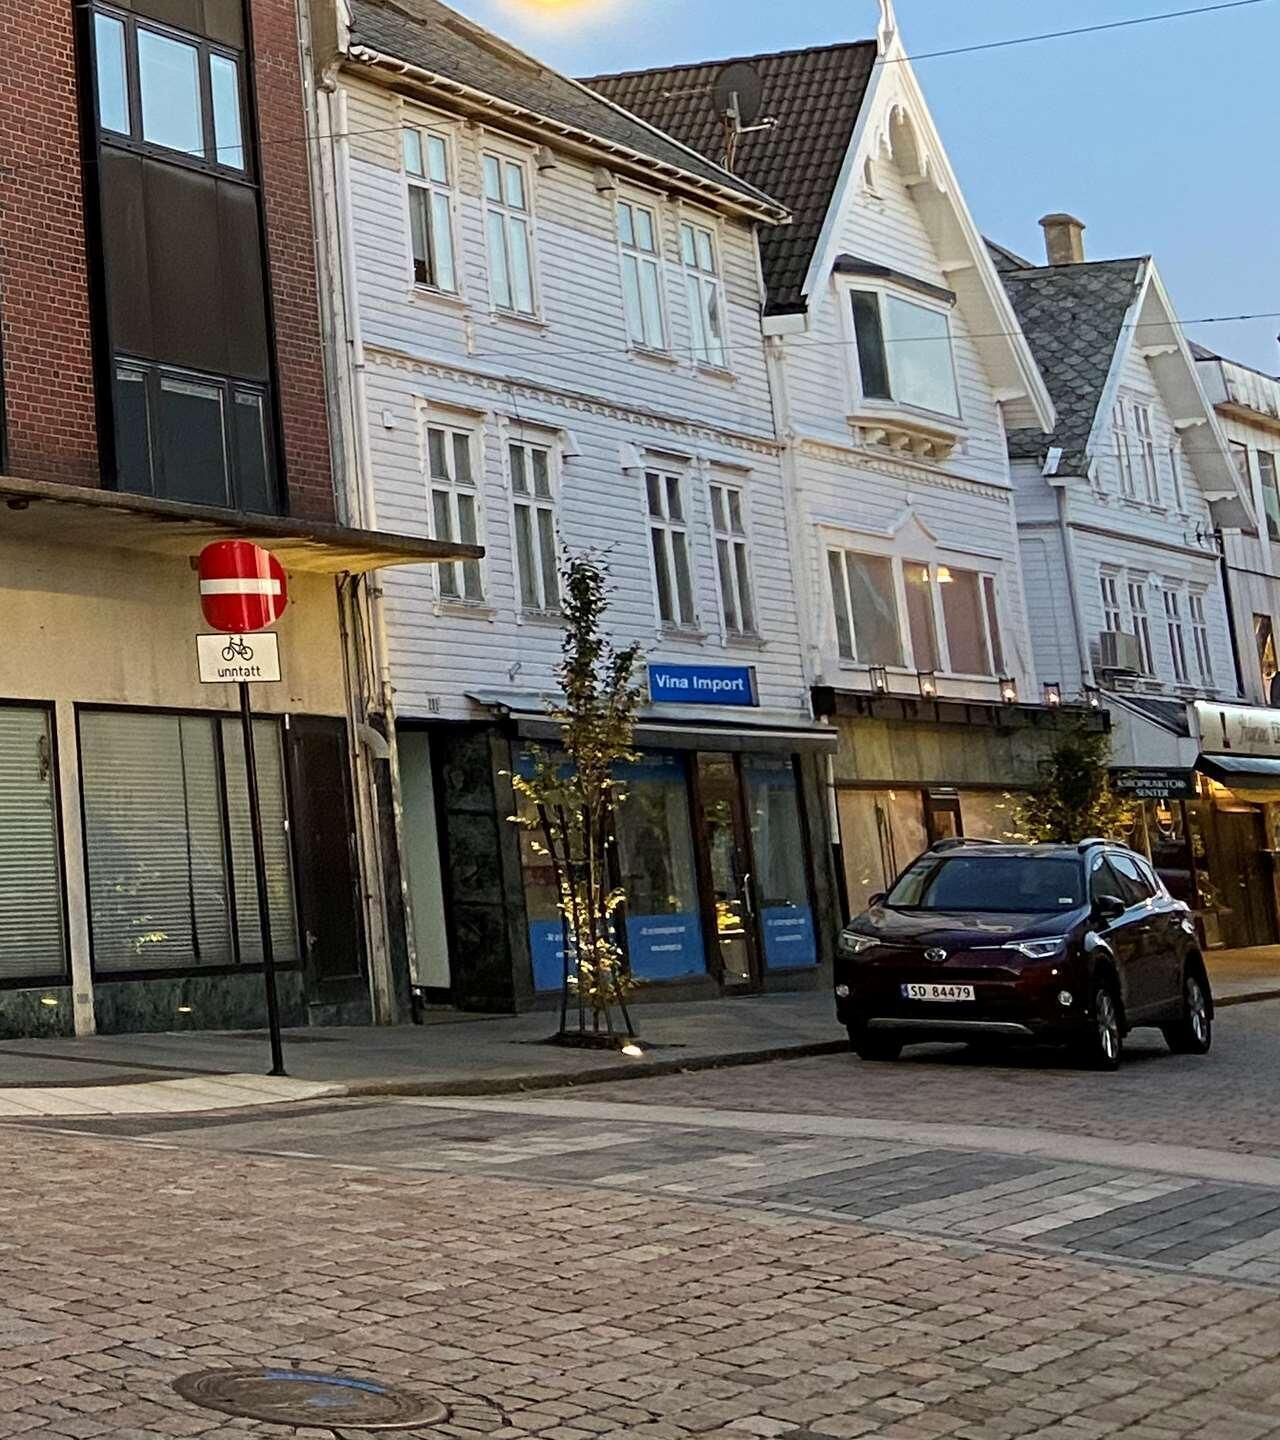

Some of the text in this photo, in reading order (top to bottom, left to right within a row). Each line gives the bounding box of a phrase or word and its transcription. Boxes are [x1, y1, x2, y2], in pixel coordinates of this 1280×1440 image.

[218, 664, 262, 677] unntatt
[655, 673, 744, 693] Vina Import
[910, 985, 971, 998] SD 84479
